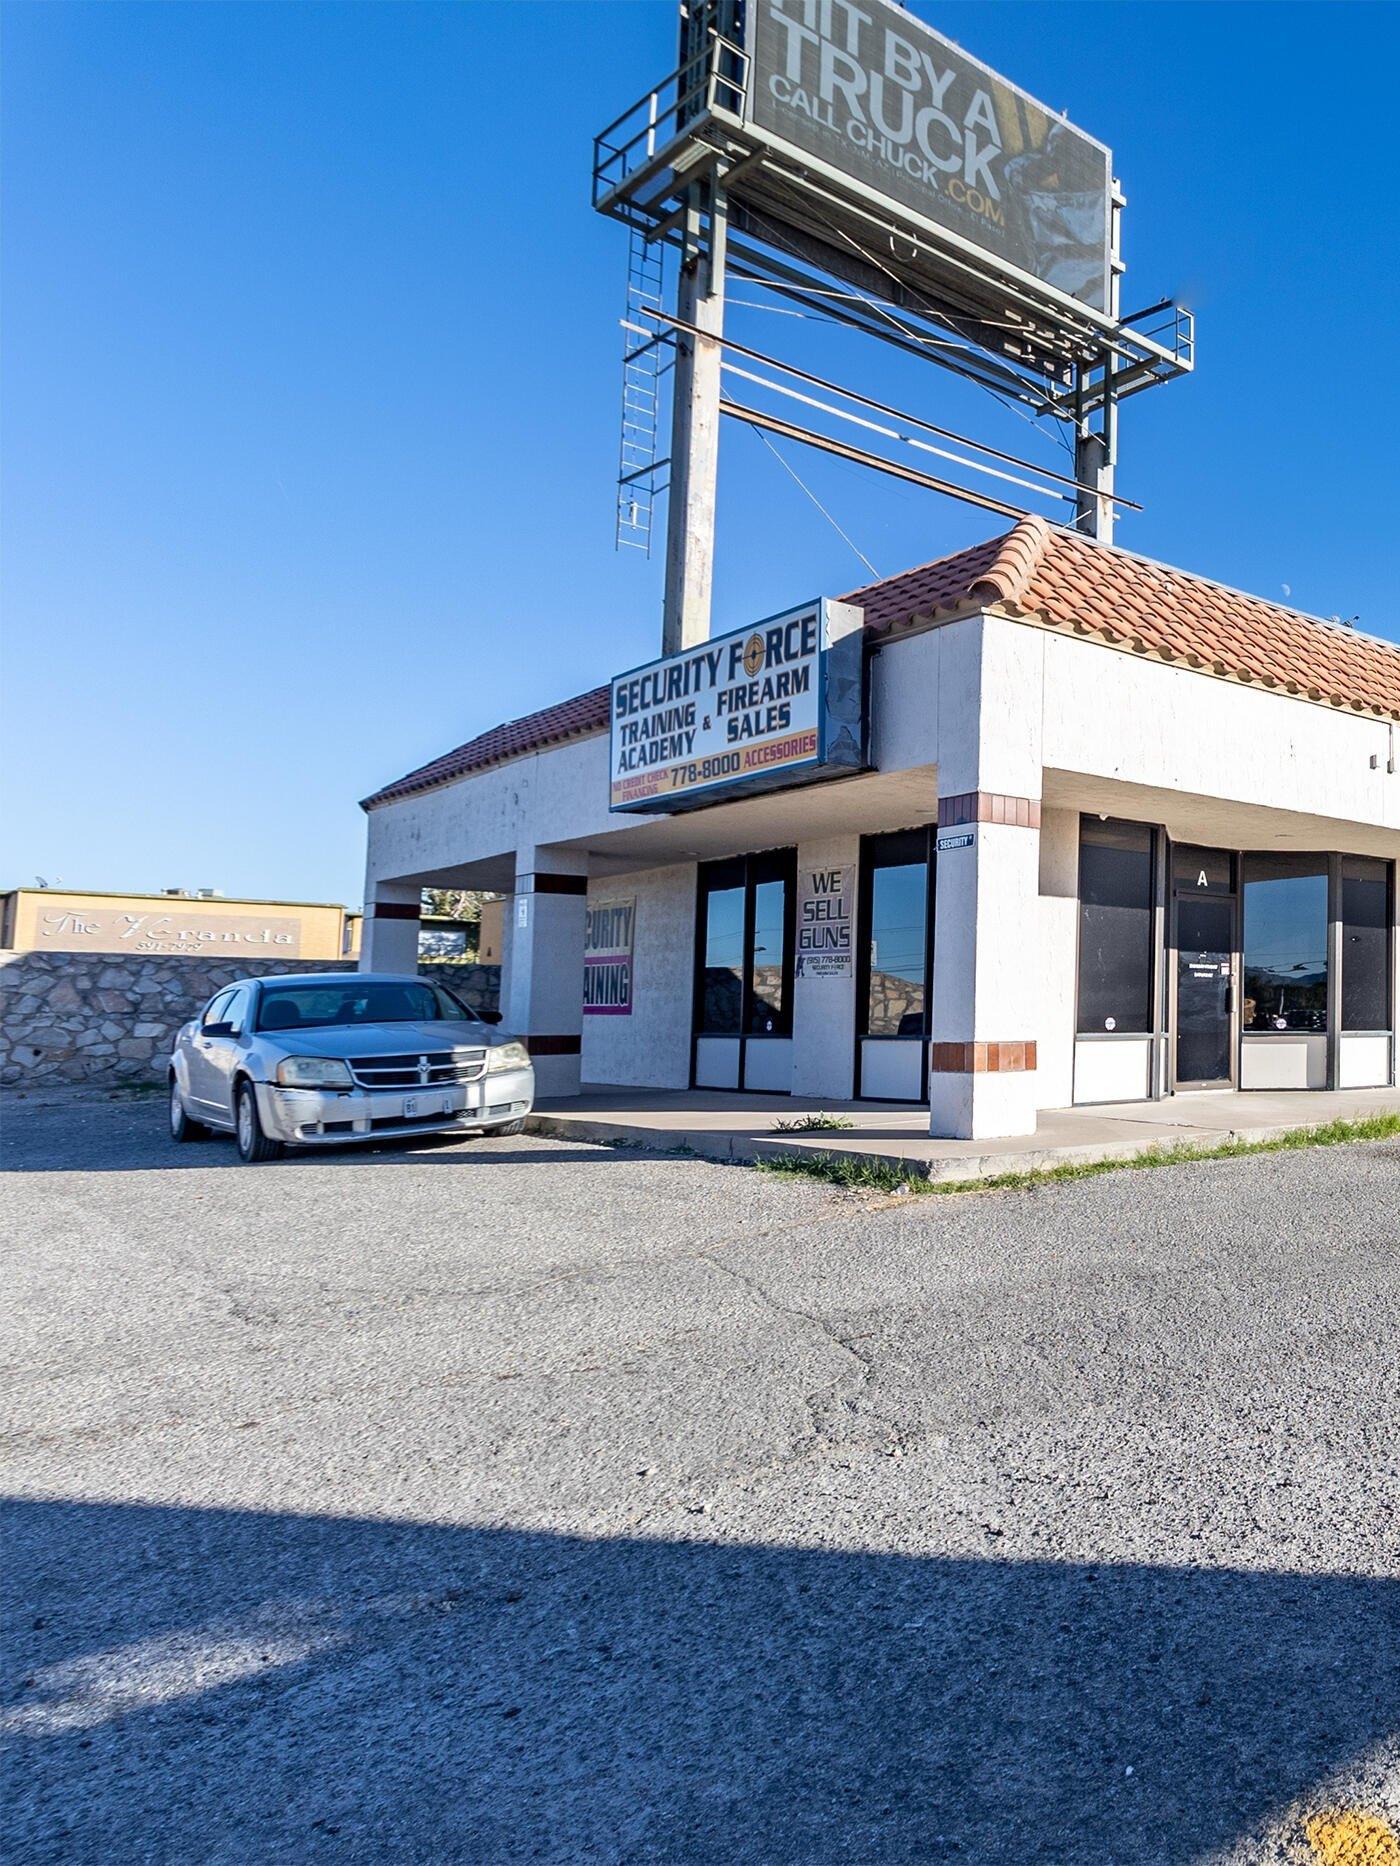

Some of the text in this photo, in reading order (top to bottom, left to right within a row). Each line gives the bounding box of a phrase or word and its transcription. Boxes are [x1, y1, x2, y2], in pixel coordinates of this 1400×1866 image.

[769, 7, 1003, 201] TRUCK
[884, 28, 957, 110] BY
[963, 88, 1003, 148] A
[769, 74, 842, 134] CALL
[846, 119, 939, 190] CHUCK
[615, 647, 723, 719] SECURITY
[716, 664, 810, 717] FIREARM
[620, 702, 696, 747] TRAINING
[702, 715, 711, 731] &
[727, 702, 791, 743] SALES
[617, 728, 697, 774] ACADEMY
[743, 733, 817, 768] ACCESSORIES
[623, 773, 645, 790] CREDIT
[647, 770, 669, 785] CHECK
[671, 752, 740, 787] 778-8000
[812, 871, 841, 894] WE
[1197, 870, 1208, 886] A
[803, 898, 849, 922] SELL
[43, 911, 294, 945] The Veranda
[800, 926, 850, 949] GUNS
